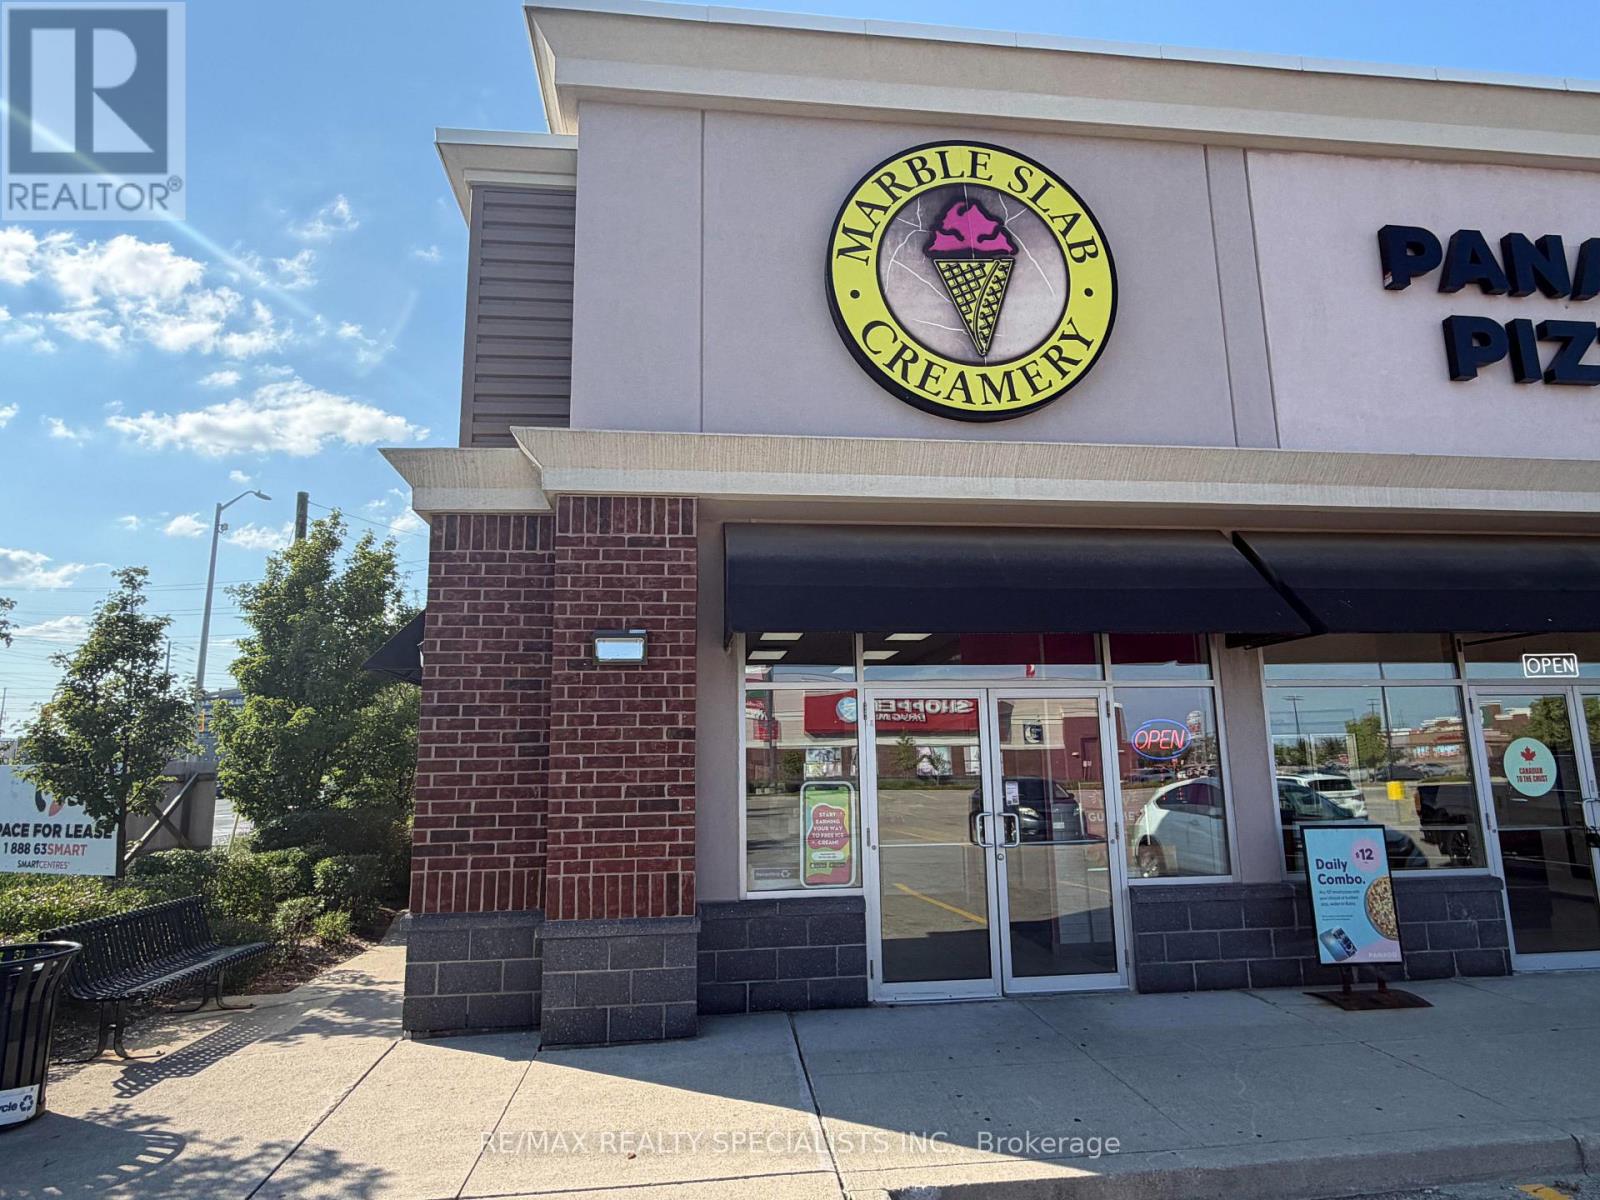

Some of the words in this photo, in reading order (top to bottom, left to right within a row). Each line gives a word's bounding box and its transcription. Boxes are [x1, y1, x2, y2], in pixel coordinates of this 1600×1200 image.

[836, 150, 993, 266] MARBLE
[1008, 165, 1099, 263] SLAB
[1442, 315, 1600, 386] PIZ
[862, 317, 1094, 405] CREAMERY
[1526, 657, 1575, 674] OPEN
[1135, 729, 1185, 749] OPEN
[0, 823, 30, 838] ACE
[33, 823, 62, 838] FOR
[4, 842, 9, 854] 1
[11, 842, 31, 855] 888
[34, 843, 88, 857] 63SMART
[1356, 848, 1374, 861] $12
[1316, 858, 1347, 872] Daily
[1318, 873, 1366, 885] Combo.
